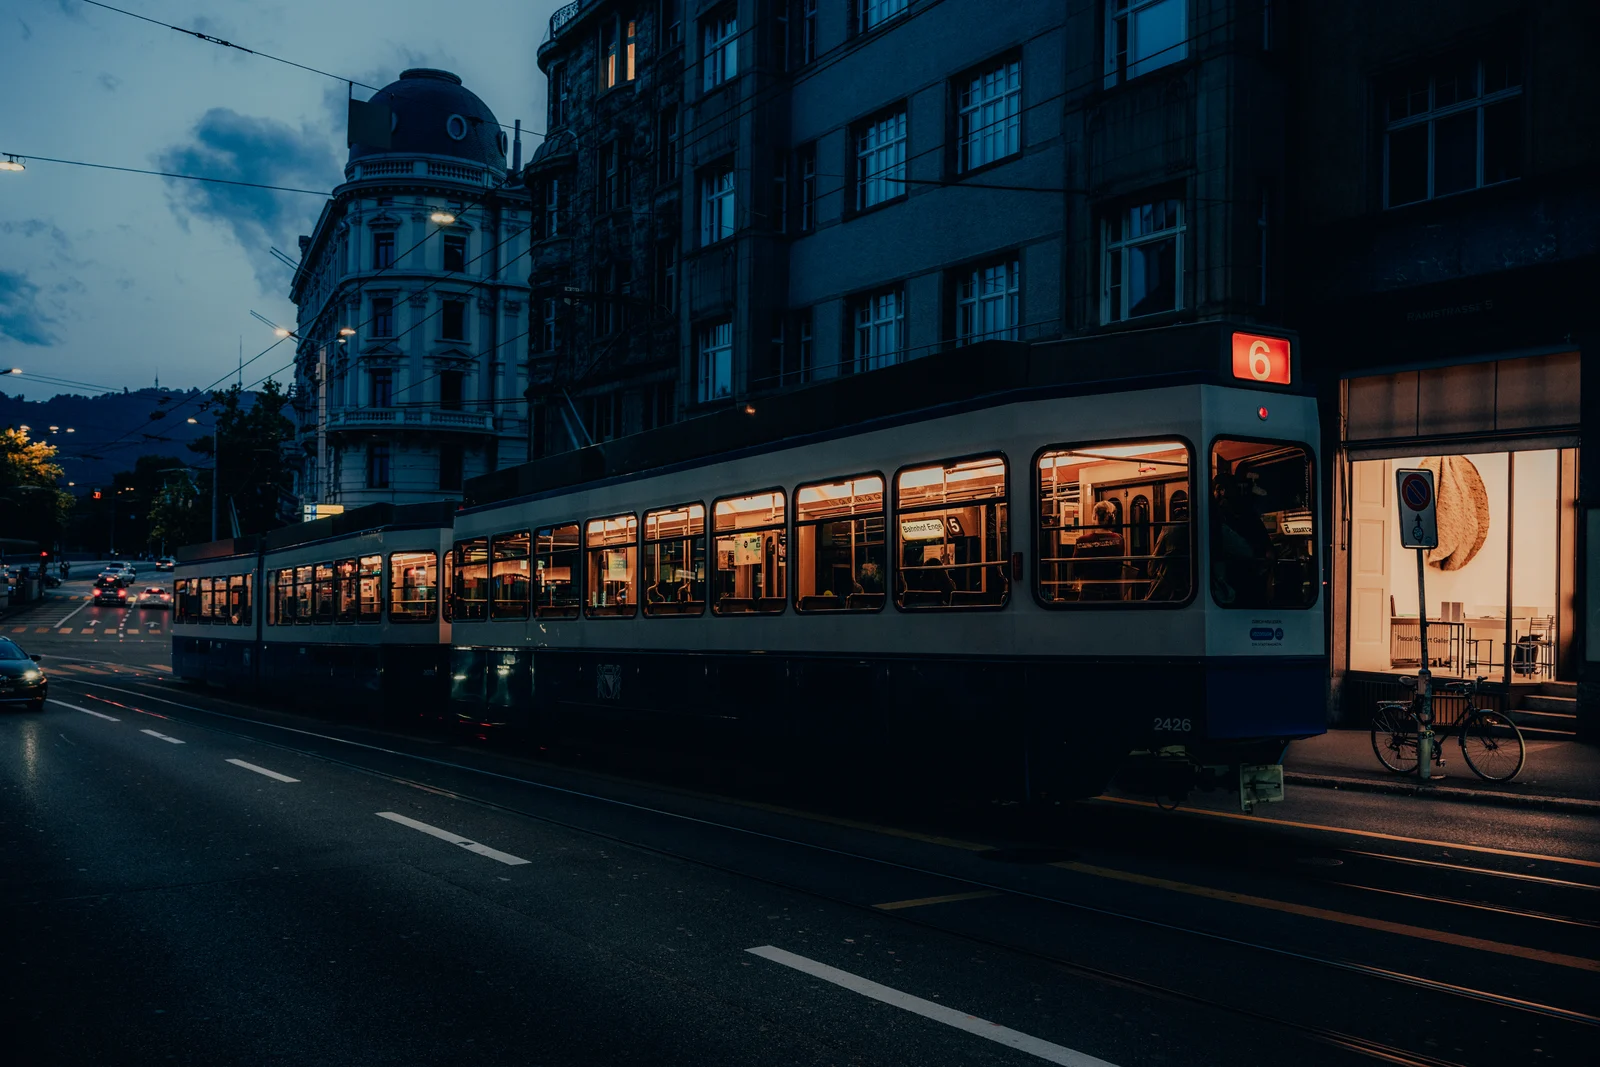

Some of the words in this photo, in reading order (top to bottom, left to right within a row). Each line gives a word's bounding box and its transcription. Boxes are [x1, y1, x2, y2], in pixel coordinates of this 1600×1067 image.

[1485, 299, 1494, 310] 5
[1249, 340, 1271, 381] 6
[902, 523, 927, 534] Bahnhof
[927, 522, 943, 532] Enge
[949, 518, 961, 533] 5
[1153, 717, 1192, 732] 2426
